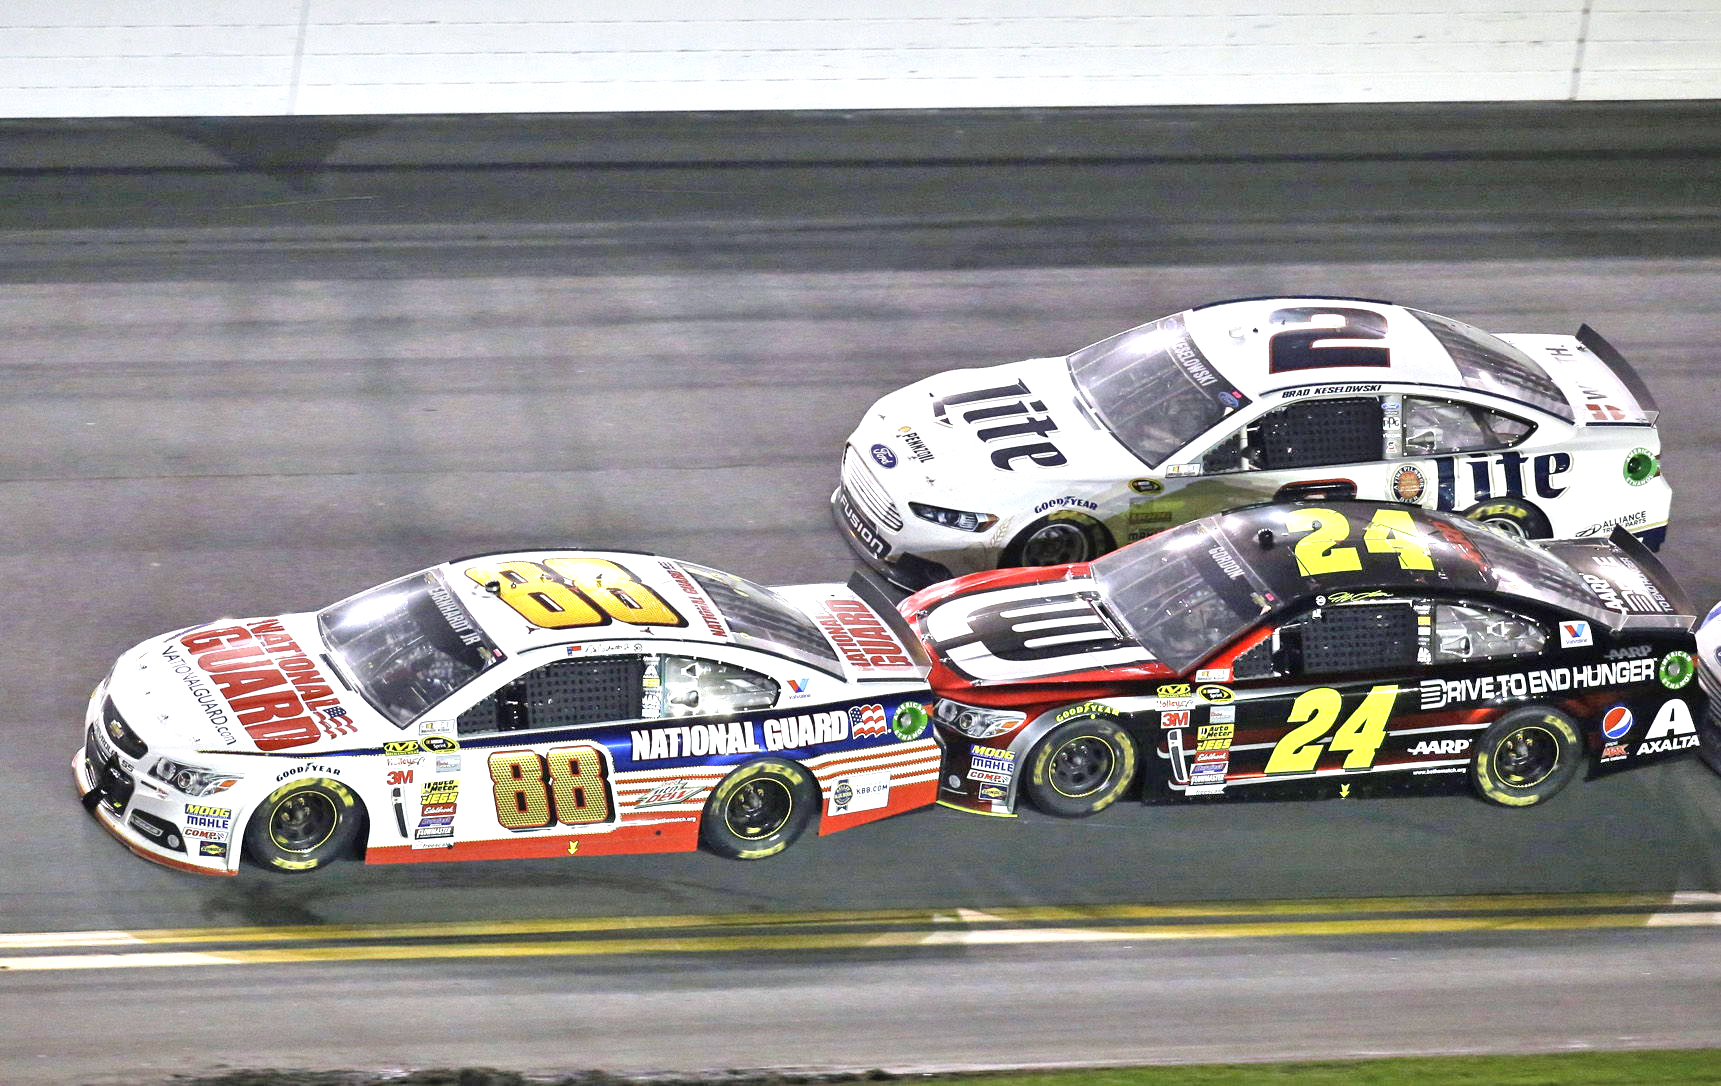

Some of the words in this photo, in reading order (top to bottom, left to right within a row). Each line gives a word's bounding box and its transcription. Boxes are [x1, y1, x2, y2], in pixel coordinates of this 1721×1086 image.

[1269, 306, 1390, 374] 2
[1281, 388, 1310, 398] BRAD
[1314, 384, 1382, 395] KESELOWSKI
[872, 446, 895, 467] Ford
[902, 431, 936, 464] PENNZOIL
[1034, 496, 1098, 515] GOODYEAR
[839, 496, 886, 556] FUSION
[1603, 510, 1647, 528] ALLIANCE
[1625, 518, 1647, 527] PARTS
[1285, 507, 1435, 576] 24
[1208, 544, 1246, 581] GORDON
[464, 557, 690, 630] 88
[428, 586, 470, 638] EARNHARDT
[459, 626, 481, 646] JR
[825, 598, 914, 668] GUARD
[246, 618, 337, 713] NATIONAL
[1659, 651, 1692, 672] AMERICAN
[180, 625, 322, 751] GUARD
[1498, 673, 1527, 698] TO
[1528, 667, 1571, 694] END
[1573, 658, 1655, 690] HUNGER
[1660, 672, 1693, 689] ETHANOL
[162, 645, 237, 746] NATIONALGUARD.com
[893, 701, 927, 720] AMERICAN
[1056, 703, 1120, 723] GOODYEAR
[1162, 711, 1189, 727] 3M
[630, 720, 761, 761] NATIONAL
[763, 709, 849, 751] GUARD
[894, 725, 926, 740] ETHANOL
[1264, 684, 1399, 777] 24
[972, 745, 1015, 759] MOOG
[1197, 738, 1232, 751] JEGS
[1407, 739, 1470, 756] AARP
[1636, 734, 1701, 756] AXALTA
[276, 762, 341, 782] GOODYEAR
[972, 758, 1014, 772] MAHLE
[386, 770, 414, 785] 3M
[970, 770, 1002, 782] COMP
[487, 744, 616, 832] 88
[421, 792, 459, 805] JEGS
[186, 804, 231, 818] MOOG
[186, 816, 229, 830] MAHLE
[184, 829, 216, 839] COMP
